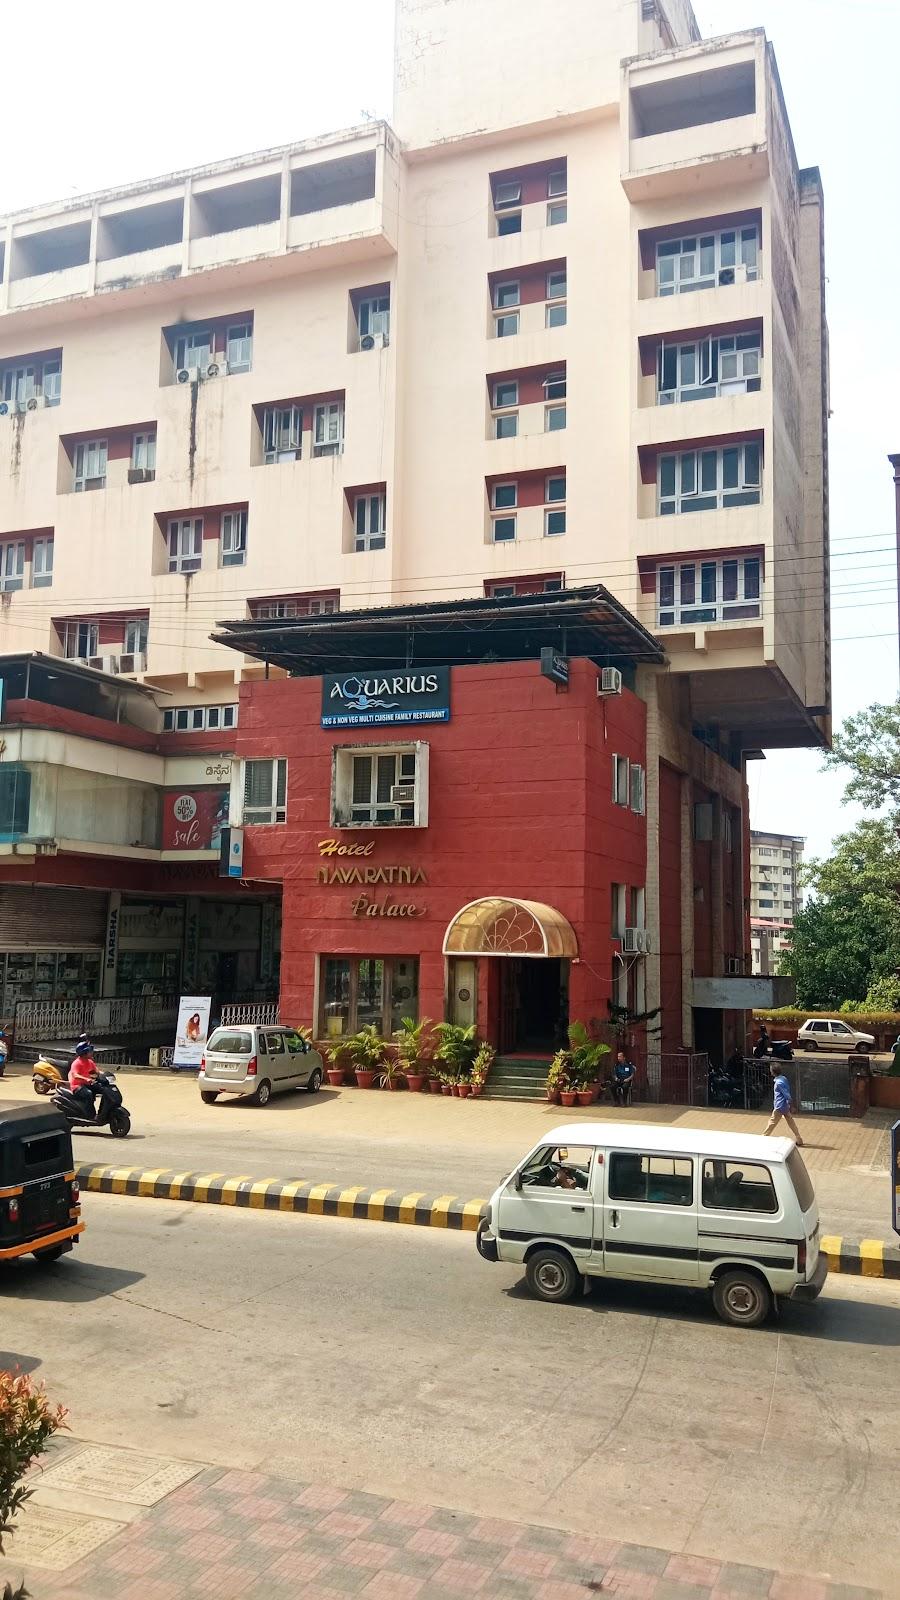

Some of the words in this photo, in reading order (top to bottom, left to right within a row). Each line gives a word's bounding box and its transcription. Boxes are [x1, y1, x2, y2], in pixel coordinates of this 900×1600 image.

[330, 674, 439, 698] AQUARIUS
[322, 717, 332, 725] VEG
[337, 716, 348, 724] NON
[358, 715, 374, 723] MULTI
[374, 714, 395, 722] CUISINE
[395, 712, 413, 721] FAMILY
[412, 711, 446, 720] RESTAURANT
[177, 806, 194, 815] 50%
[173, 819, 201, 846] sale
[317, 839, 375, 856] Hotel
[317, 866, 427, 884] NAVARATNA
[351, 893, 427, 916] Palace
[107, 908, 118, 969] HARSHA
